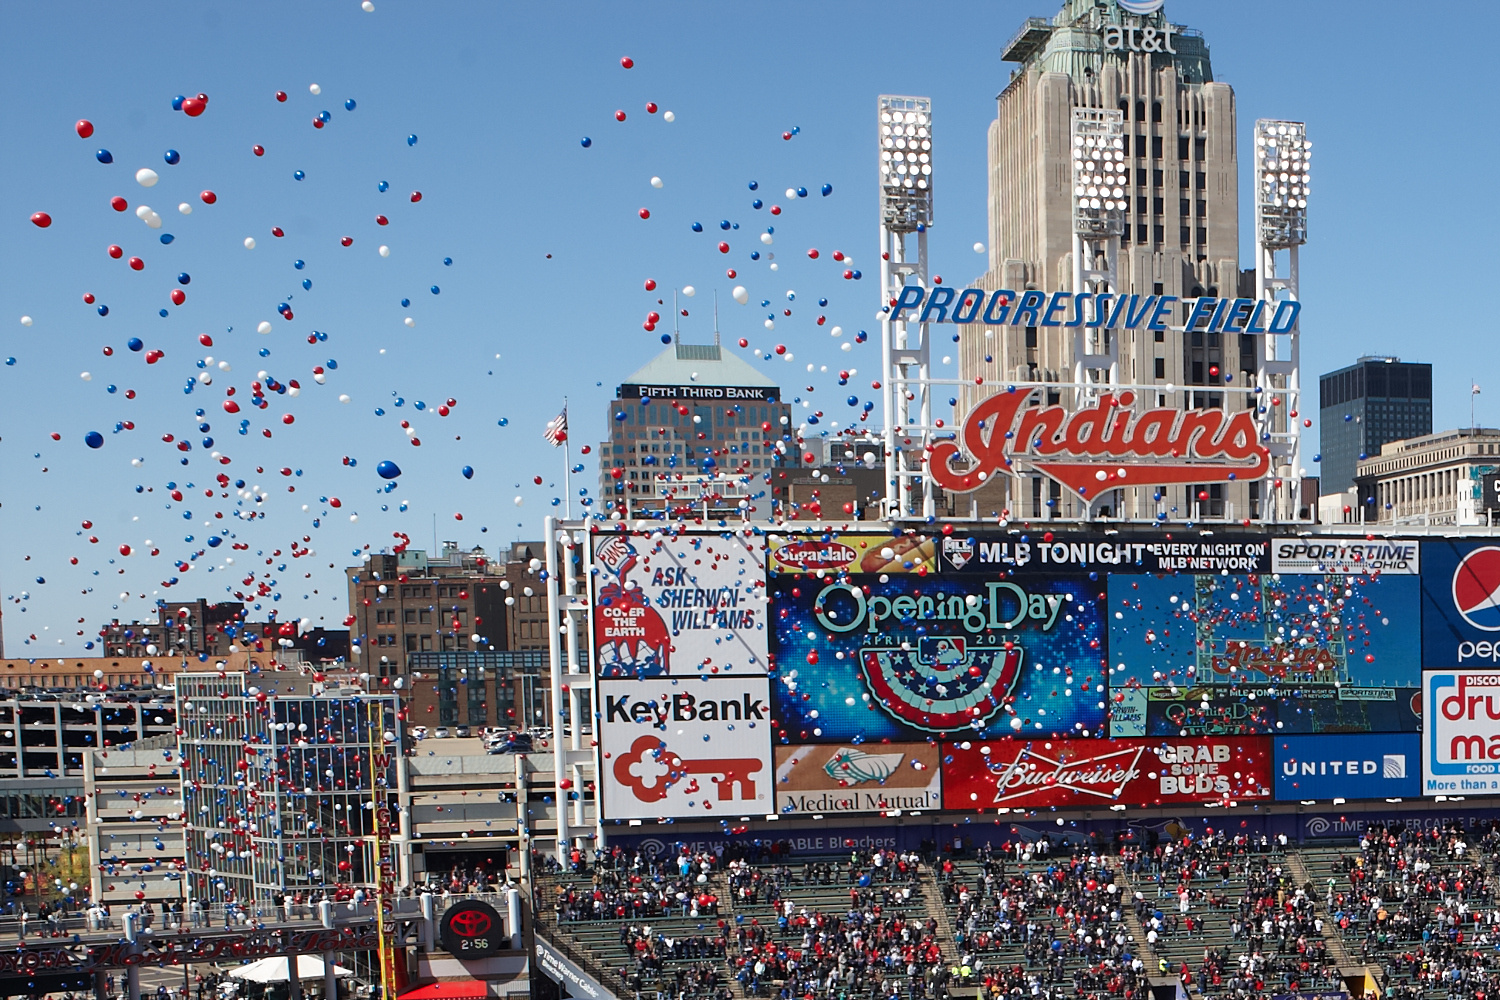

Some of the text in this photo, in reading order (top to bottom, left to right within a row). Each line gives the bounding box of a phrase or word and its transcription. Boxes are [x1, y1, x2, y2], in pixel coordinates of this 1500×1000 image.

[1103, 19, 1177, 55] at&t
[890, 285, 1301, 335] PROGRESSIVE FIELD
[638, 386, 764, 398] FIFTH THIRD BANK
[928, 387, 1272, 494] Indians
[944, 540, 971, 551] MLB
[980, 541, 1142, 565] MLB TONIGHT
[1153, 544, 1265, 556] EVERY NIGHT ON
[1277, 544, 1414, 562] SPORTSTIME
[779, 545, 856, 567] Sugardale
[1158, 557, 1258, 569] MLB NETWORK
[1370, 561, 1408, 570] OHIO
[651, 567, 687, 587] ASK
[814, 582, 1064, 633] Opening Day
[612, 618, 636, 626] THE
[672, 610, 755, 630] WILLIAMS
[605, 628, 645, 636] EARTH
[862, 635, 911, 645] APRIL
[975, 634, 1021, 645] 2012
[606, 693, 764, 728] KeyBank
[1159, 745, 1231, 763] GRAB
[990, 762, 1141, 788] Budweiser
[1171, 764, 1219, 775] SOME
[1283, 761, 1377, 776] UNITED
[1466, 765, 1495, 774] FOOD
[1160, 776, 1230, 794] BUDS
[1427, 779, 1457, 791] More
[1461, 779, 1487, 789] than
[1491, 780, 1498, 788] a
[788, 790, 931, 812] Medical Mutual
[1332, 819, 1363, 831] TIME
[668, 842, 706, 855] TIME
[829, 836, 896, 849] Bleachers
[461, 939, 488, 949] 2:56
[544, 950, 597, 997] Time Warner Cable
